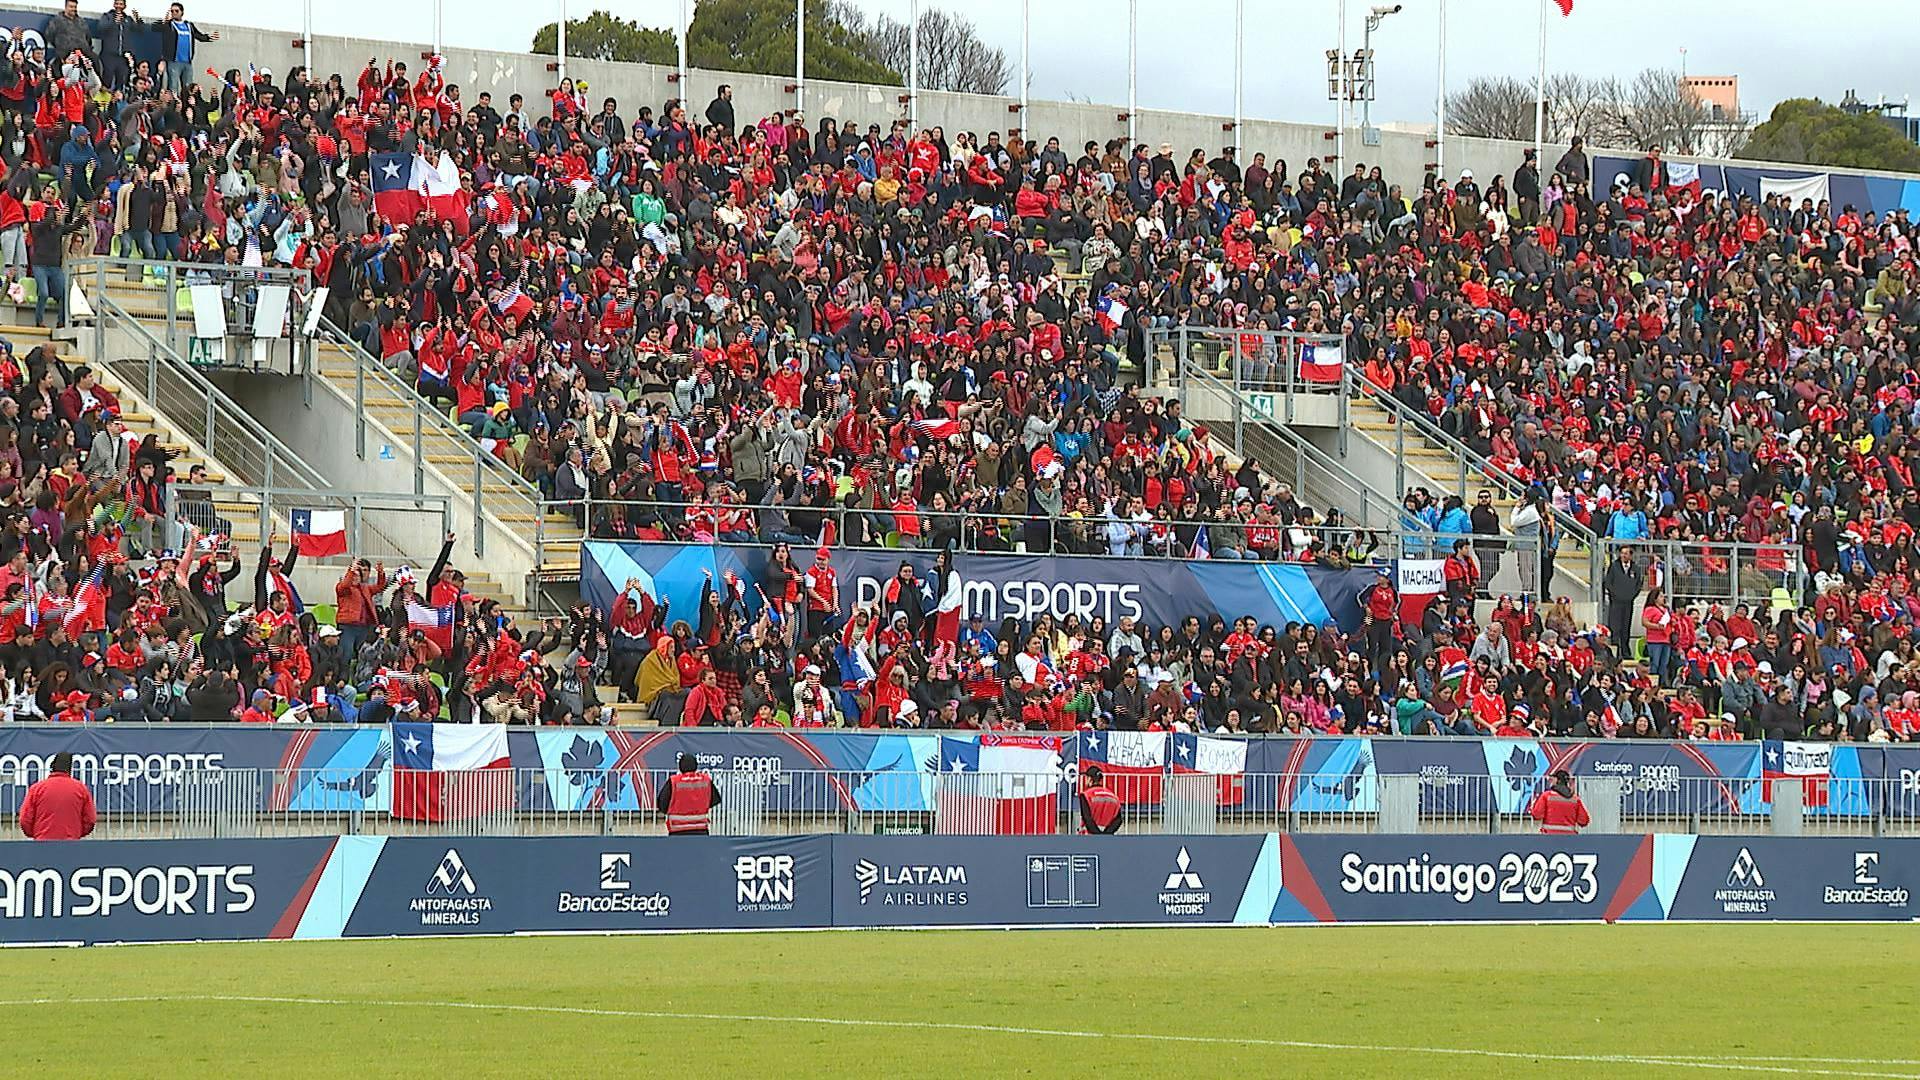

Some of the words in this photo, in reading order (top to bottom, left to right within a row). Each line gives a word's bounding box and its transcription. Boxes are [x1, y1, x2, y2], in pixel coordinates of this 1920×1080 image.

[1002, 581, 1142, 624] SPORTS
[1111, 731, 1144, 751] VILLA
[676, 752, 723, 766] Stiago
[733, 757, 781, 771] PANAM
[103, 753, 224, 785] SPORTS
[1420, 766, 1449, 775] JUEGOS
[1594, 761, 1633, 772] Santiago
[1640, 765, 1679, 778] PANAM
[733, 855, 794, 879] BOR
[882, 866, 967, 884] LATAM
[1340, 852, 1497, 903] Santiago
[1498, 853, 1599, 903] 2023
[70, 865, 255, 916] SPORTS
[737, 879, 794, 903] NAN
[1714, 889, 1776, 901] ANTOFAGASTA
[1823, 886, 1909, 904] BancoEstado
[409, 898, 492, 911] ANTOFAGASTA
[558, 892, 670, 912] BancoEstado
[883, 893, 968, 905] AIRLINES
[1158, 893, 1210, 904] MITSUBISHI
[1165, 904, 1204, 915] MOTORS
[1723, 902, 1767, 912] MINERALS
[421, 912, 480, 925] MINERALS
